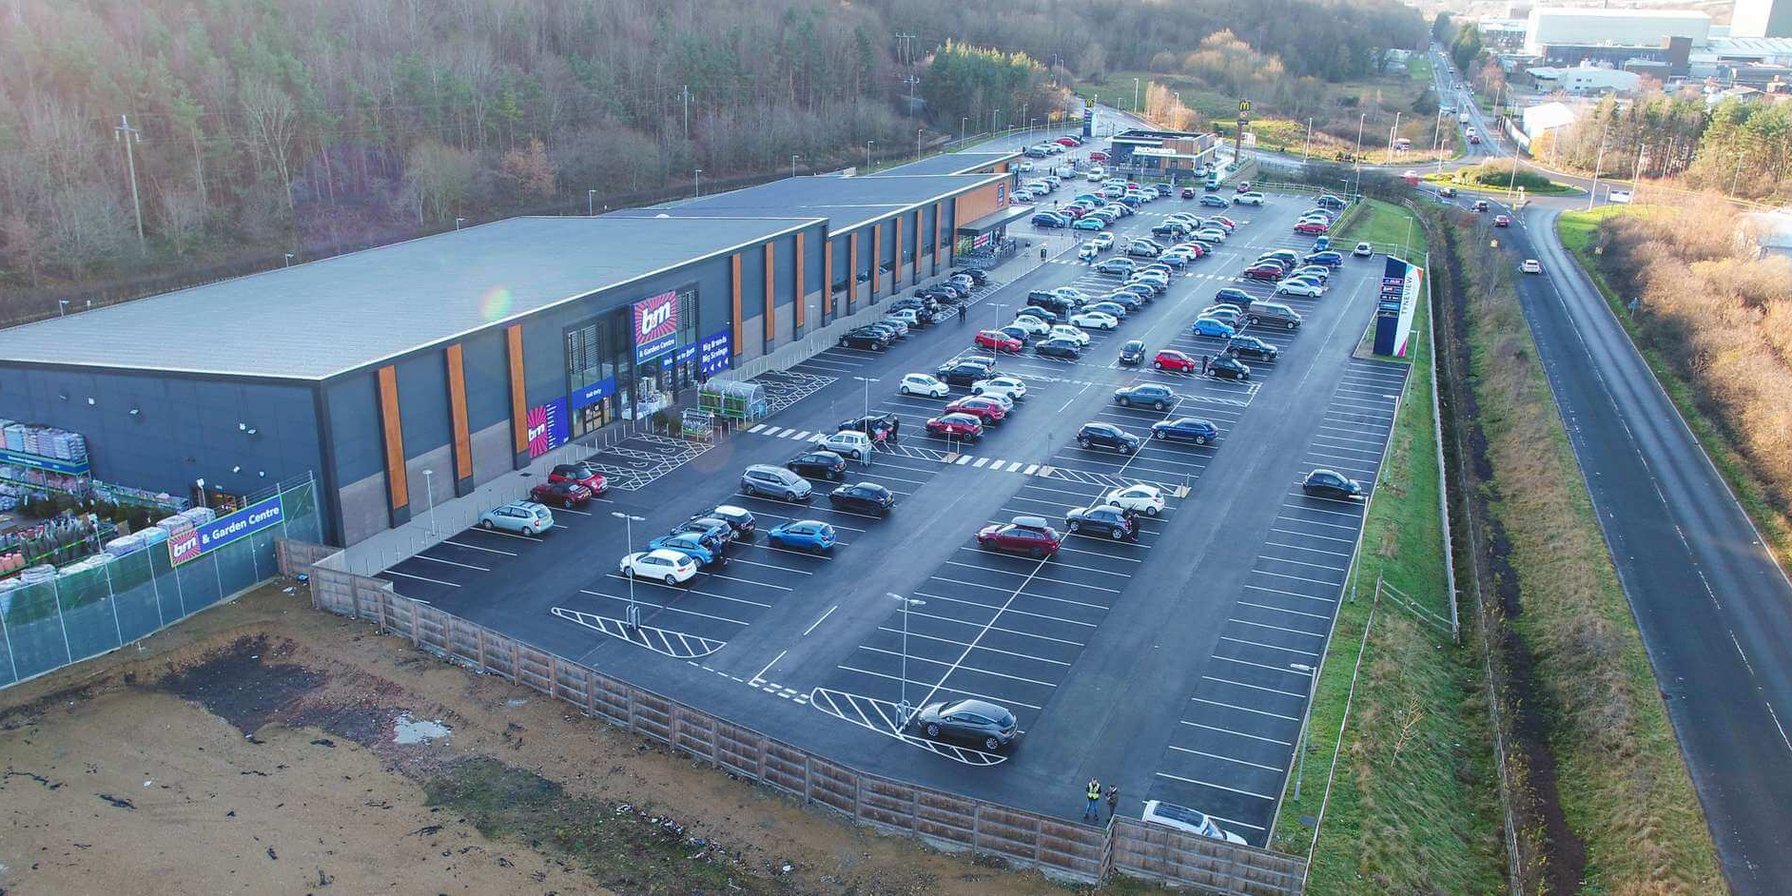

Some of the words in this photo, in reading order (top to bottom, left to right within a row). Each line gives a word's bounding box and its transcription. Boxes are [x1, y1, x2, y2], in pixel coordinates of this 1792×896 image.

[643, 345, 660, 356] Garden
[202, 534, 210, 545] &
[212, 520, 247, 540] Garden
[248, 506, 280, 525] Centre
